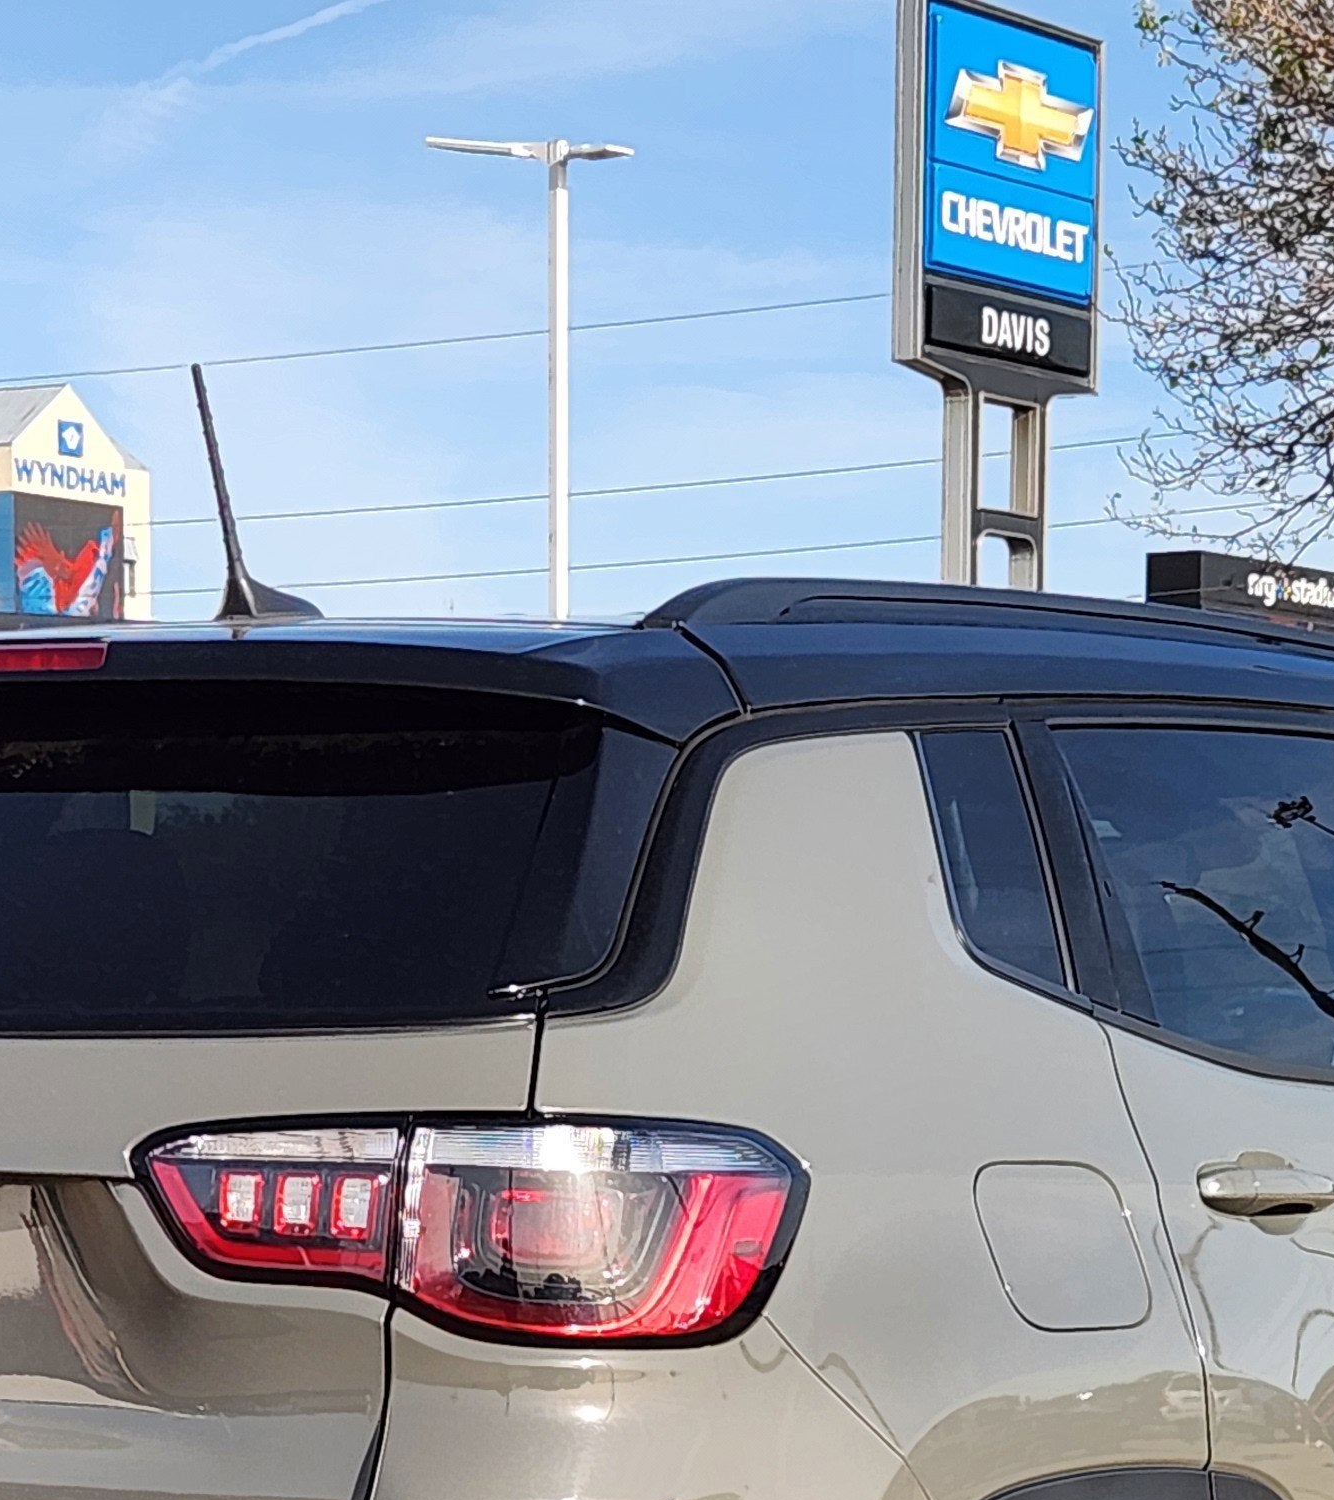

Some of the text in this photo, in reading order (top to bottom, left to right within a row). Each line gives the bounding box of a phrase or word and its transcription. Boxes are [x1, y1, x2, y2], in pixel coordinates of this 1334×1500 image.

[942, 190, 1090, 263] CHEVROLET
[982, 306, 1051, 357] DAVIS
[14, 459, 126, 497] WYNDHAM
